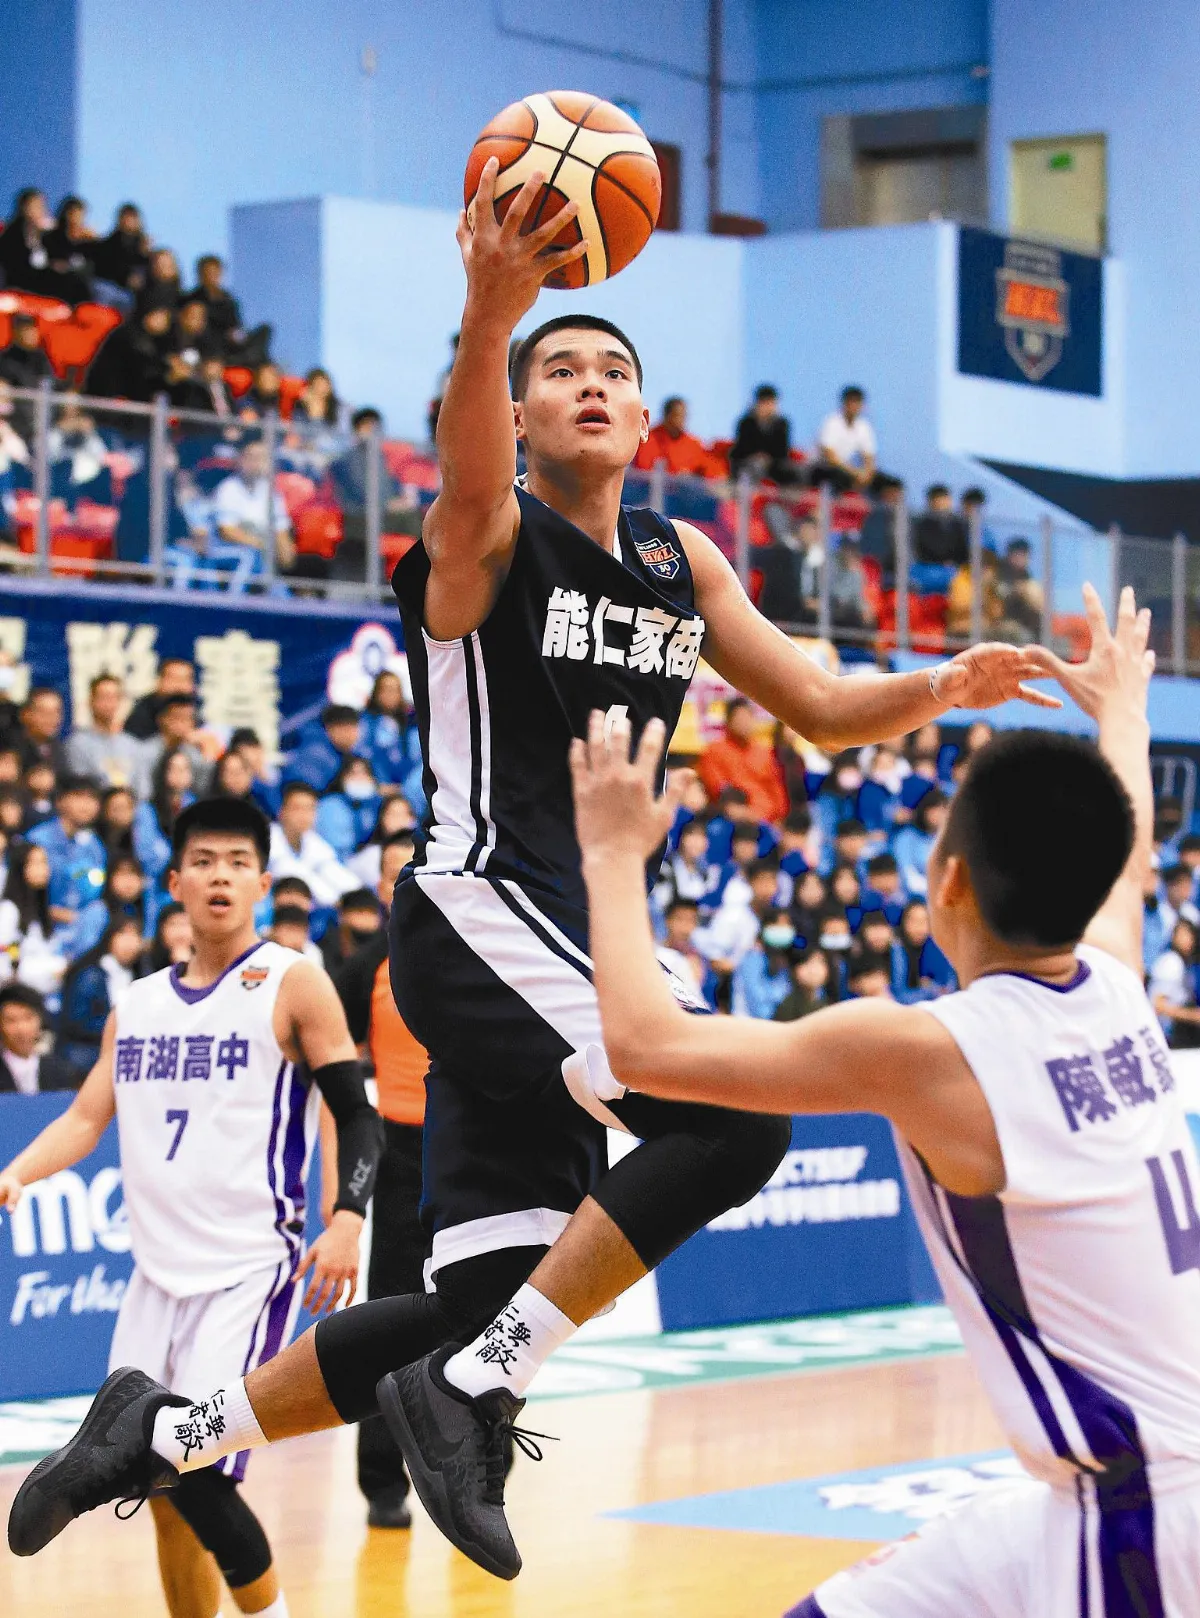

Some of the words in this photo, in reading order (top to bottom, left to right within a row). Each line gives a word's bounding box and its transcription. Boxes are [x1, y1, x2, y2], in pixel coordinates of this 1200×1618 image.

[541, 585, 706, 680] 能仁家商
[114, 1032, 249, 1083] 南湖高中
[165, 1109, 189, 1161] 7
[10, 1270, 72, 1326] For
